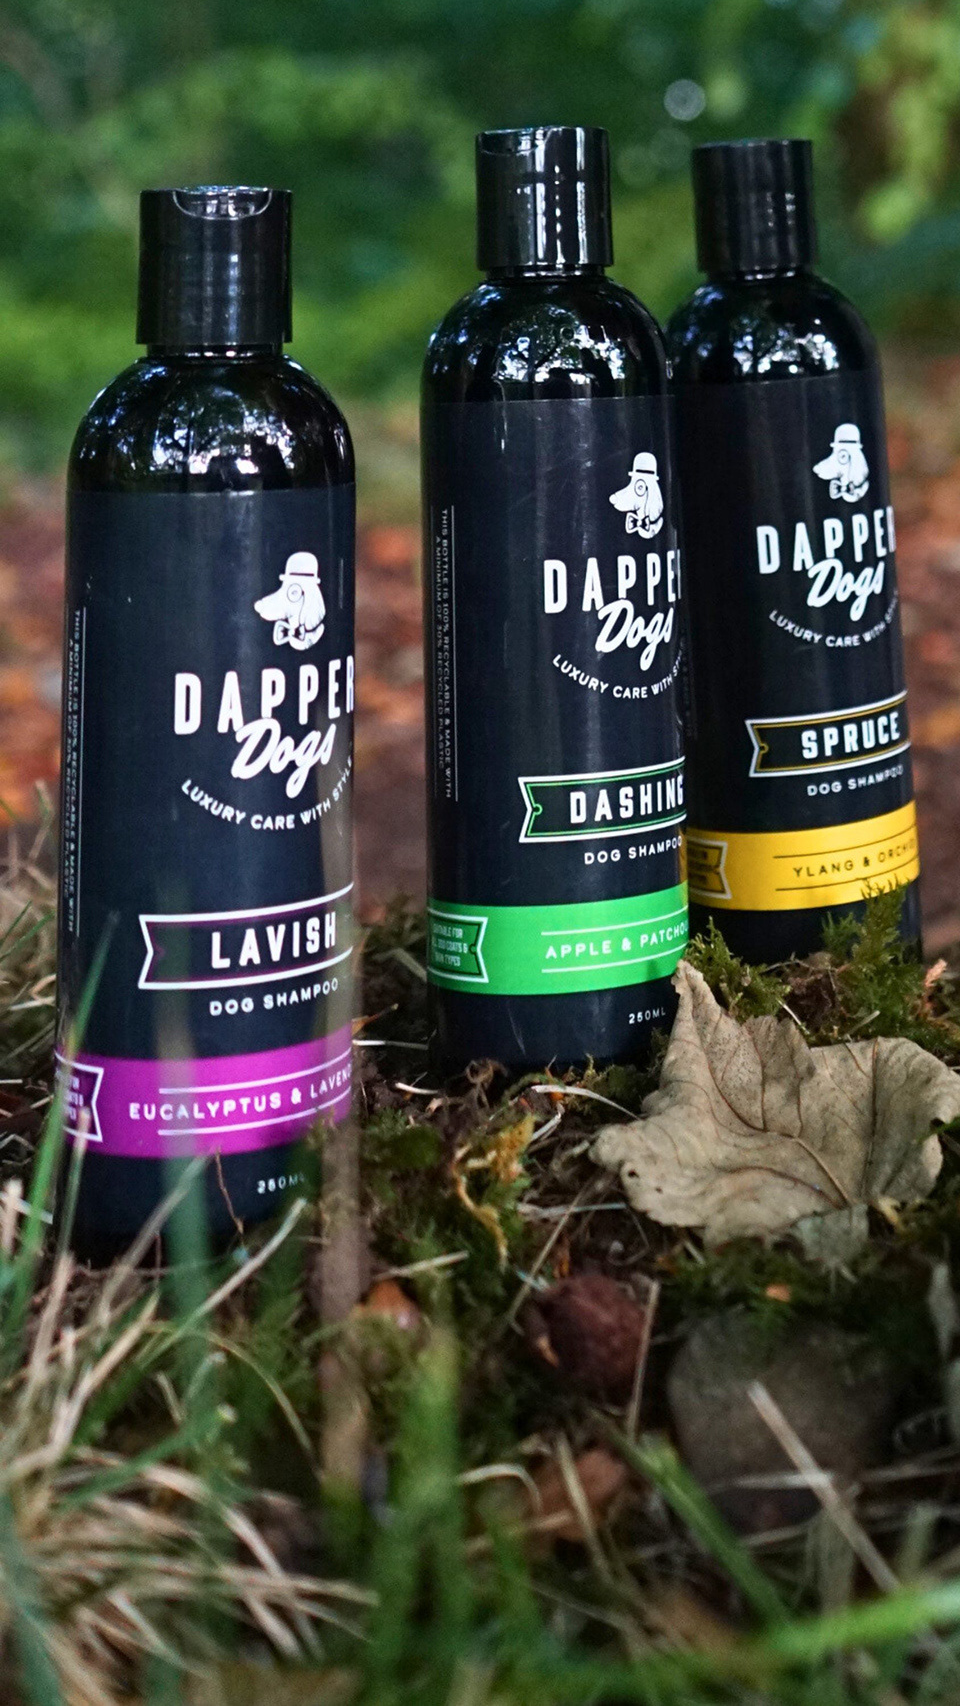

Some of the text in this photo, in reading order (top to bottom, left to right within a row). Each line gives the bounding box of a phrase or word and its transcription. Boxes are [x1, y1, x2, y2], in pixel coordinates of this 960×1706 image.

[441, 539, 449, 585] BOTTLE
[543, 549, 681, 614] DAPPE
[442, 588, 449, 600] IS
[806, 558, 885, 622] Dogs
[436, 604, 442, 621] OF
[769, 609, 822, 644] LUXURY
[825, 634, 861, 647] CARE
[595, 598, 674, 671] Dogs
[174, 655, 355, 735] DAPPER
[552, 654, 609, 694] LUXURY
[612, 685, 649, 699] CARE
[650, 673, 673, 696] WITH
[444, 718, 451, 726] &
[801, 711, 900, 760] SPRUCE
[230, 716, 337, 798] Dogs
[569, 774, 685, 824] DASHING
[807, 764, 904, 796] DOG SHAMPOO
[181, 779, 246, 825] LUXURY
[251, 813, 295, 831] CARE
[300, 798, 332, 825] WITH
[584, 848, 622, 865] DOG
[628, 835, 683, 859] SHAMPOO
[793, 853, 855, 877] YLANG
[863, 856, 870, 867] &
[211, 911, 337, 969] LAVISH
[545, 939, 612, 960] APPLE
[621, 936, 632, 951] &
[209, 977, 339, 1016] DOG SHAMPOO
[628, 1007, 667, 1025] 250ML
[129, 1091, 282, 1121] EUCALYPTUS
[291, 1087, 302, 1105] &
